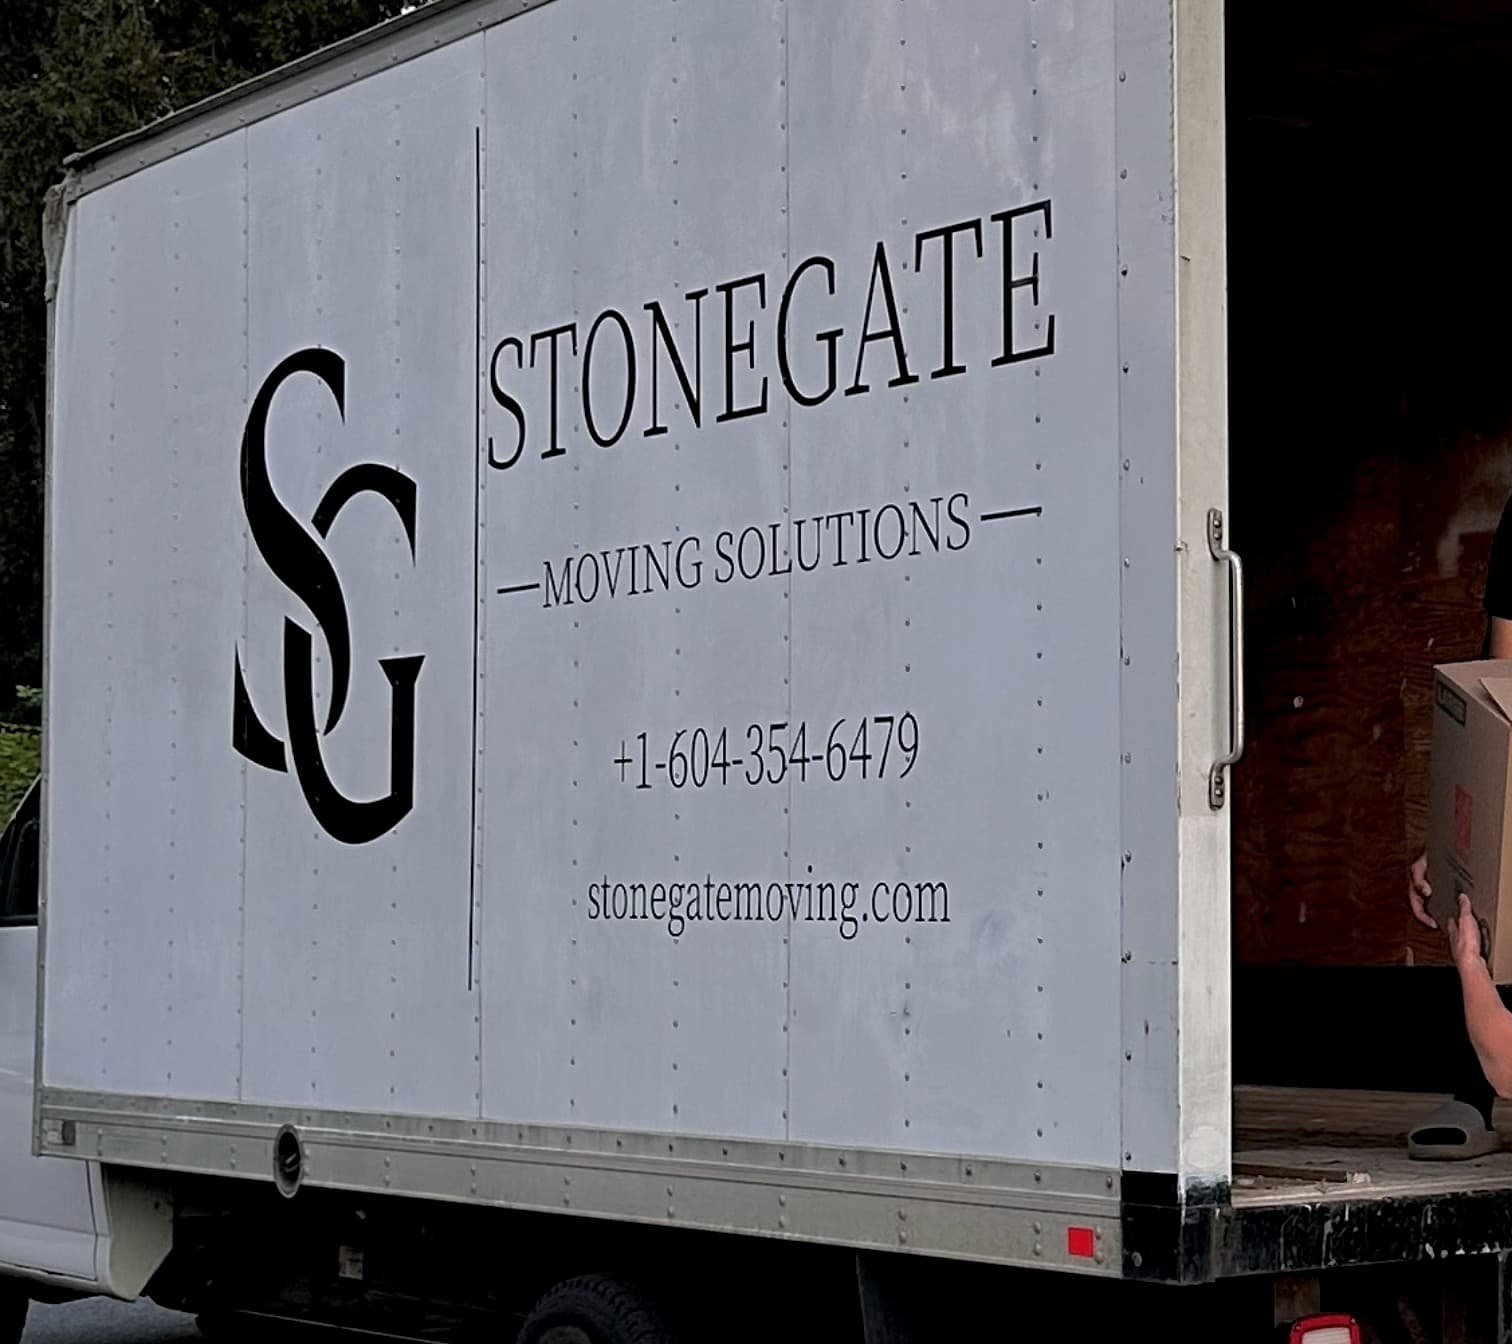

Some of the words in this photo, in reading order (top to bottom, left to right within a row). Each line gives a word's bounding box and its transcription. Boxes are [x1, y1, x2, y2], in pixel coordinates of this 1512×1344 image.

[488, 200, 1055, 469] STONEGATE
[233, 349, 424, 844] SG
[543, 537, 703, 608] MOVING
[715, 494, 970, 582] SOLUTIONS
[613, 712, 919, 789] +1-604-354-6479
[588, 866, 951, 940] stonegatemoving.com
